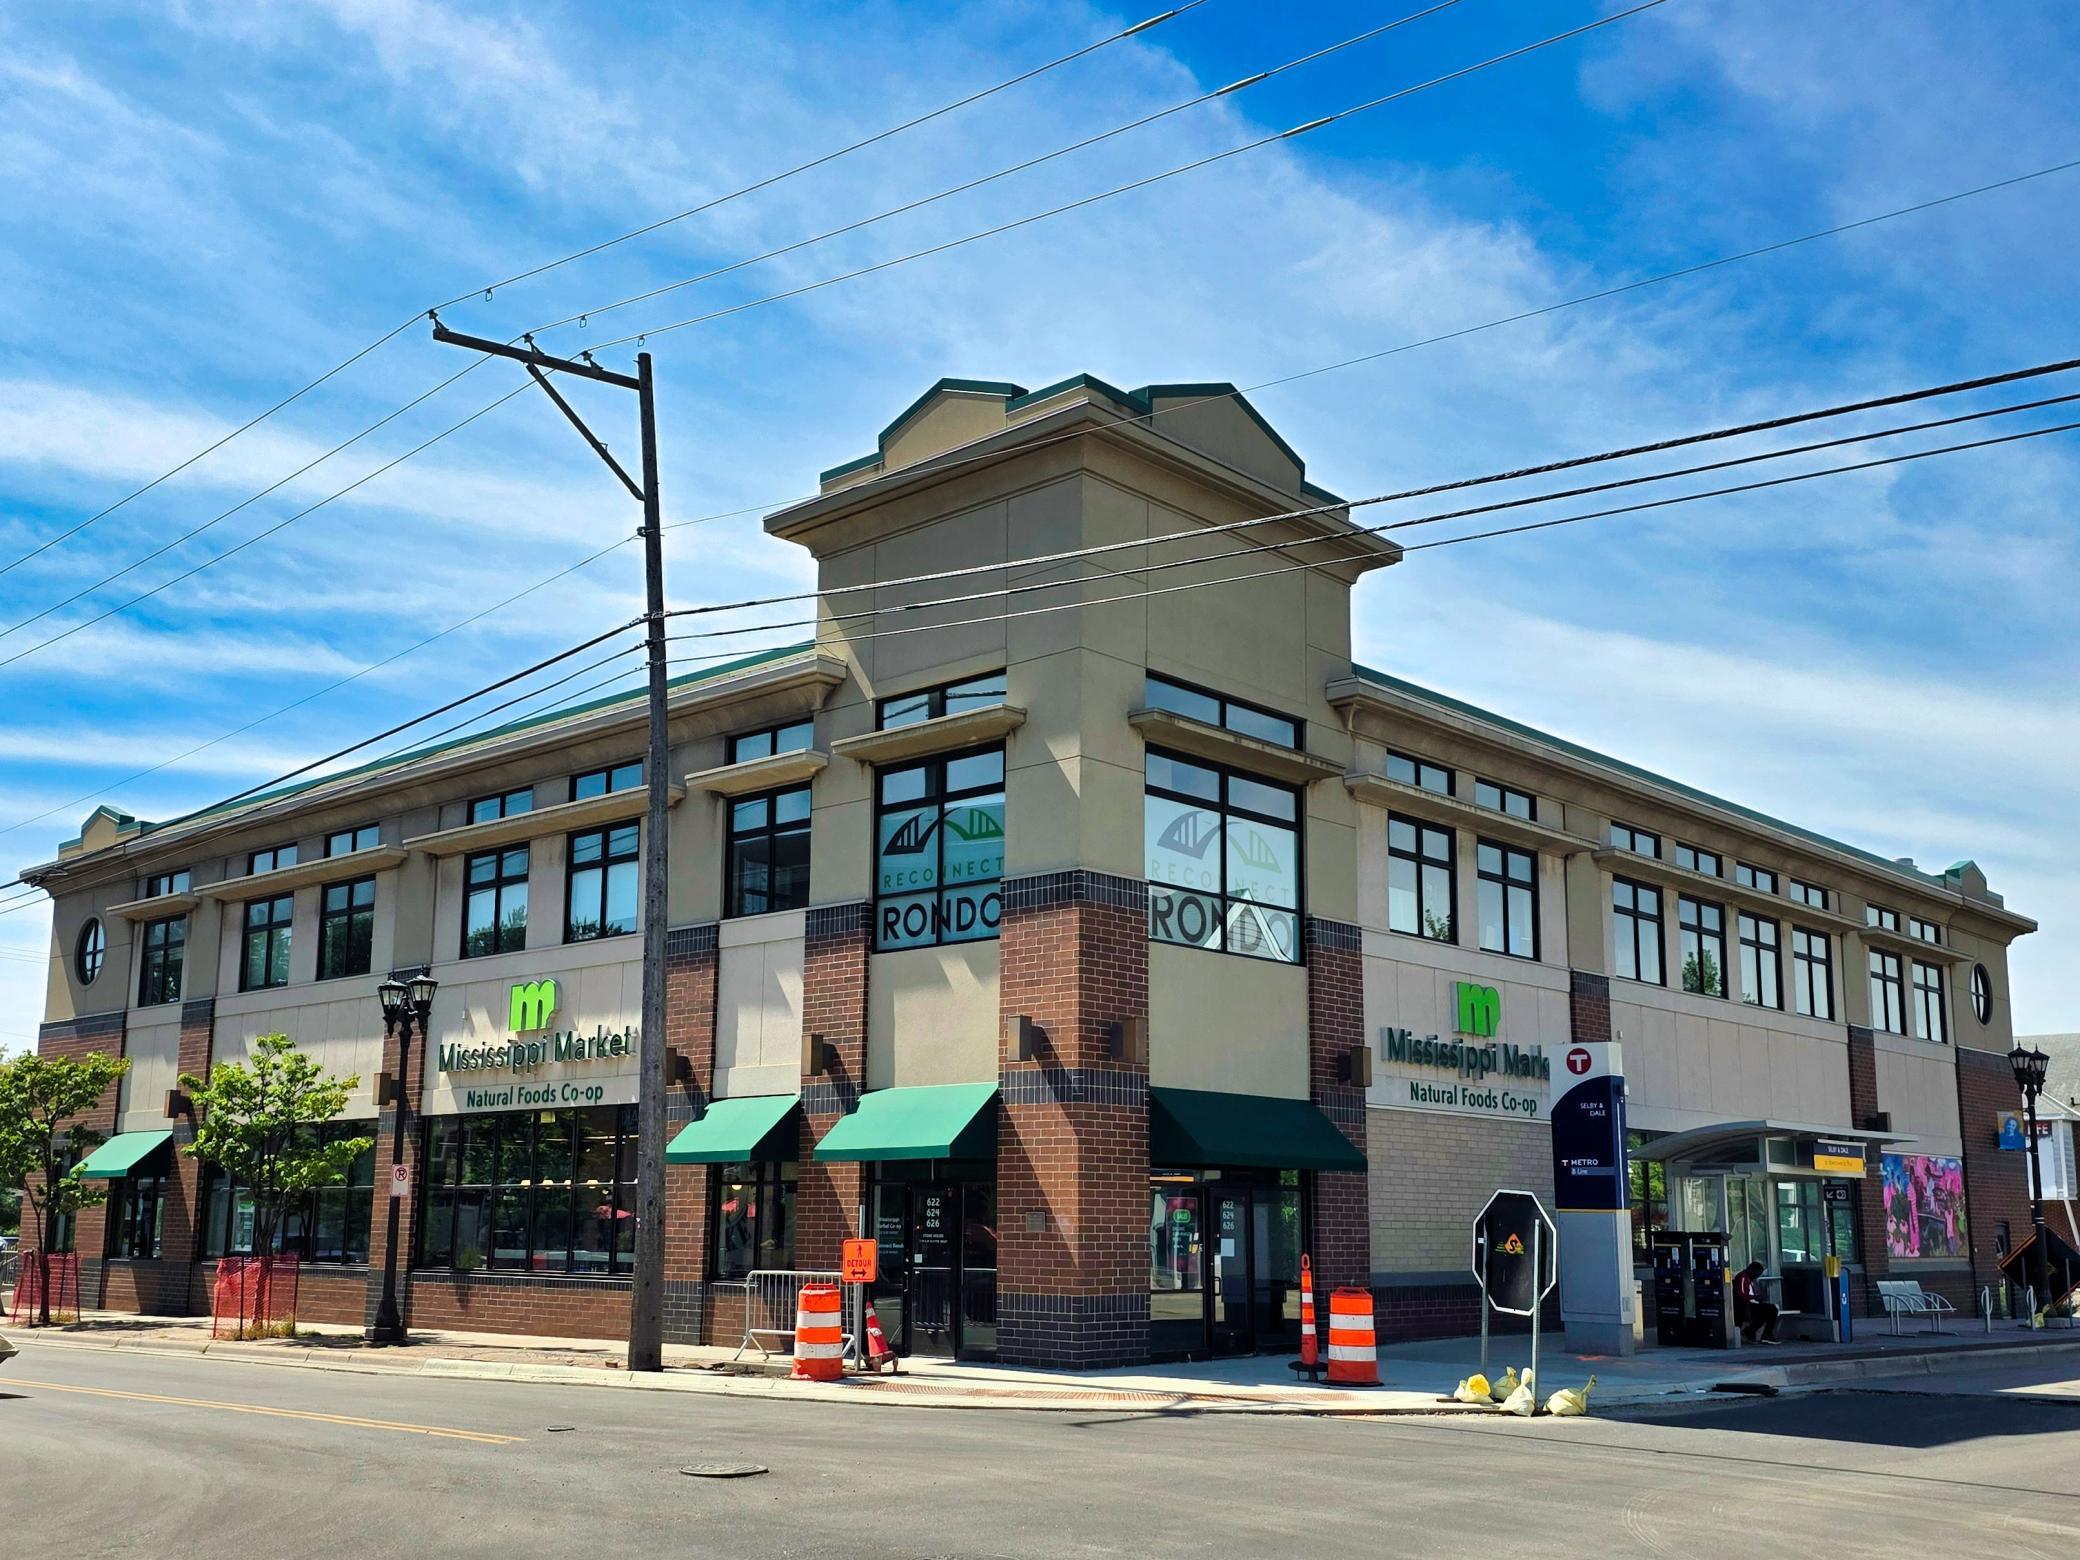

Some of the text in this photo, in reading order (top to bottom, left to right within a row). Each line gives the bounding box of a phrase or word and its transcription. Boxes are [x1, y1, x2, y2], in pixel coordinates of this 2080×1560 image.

[882, 856, 1004, 888] RECONECT
[1151, 860, 1289, 905] RECONECT
[883, 892, 1001, 941] RONDO
[439, 1025, 634, 1074] Mississippi Market
[1386, 1027, 1550, 1080] Mississippi Mark
[467, 1083, 604, 1108] Natural Foods Co-op
[1410, 1081, 1537, 1117] Natural Foods Co-op
[926, 1198, 940, 1206] 622
[1222, 1201, 1234, 1209] 622
[926, 1209, 940, 1217] 624
[1222, 1211, 1234, 1219] 624
[926, 1219, 940, 1228] 626
[1222, 1221, 1235, 1230] 626
[847, 1259, 872, 1267] DETOUR
